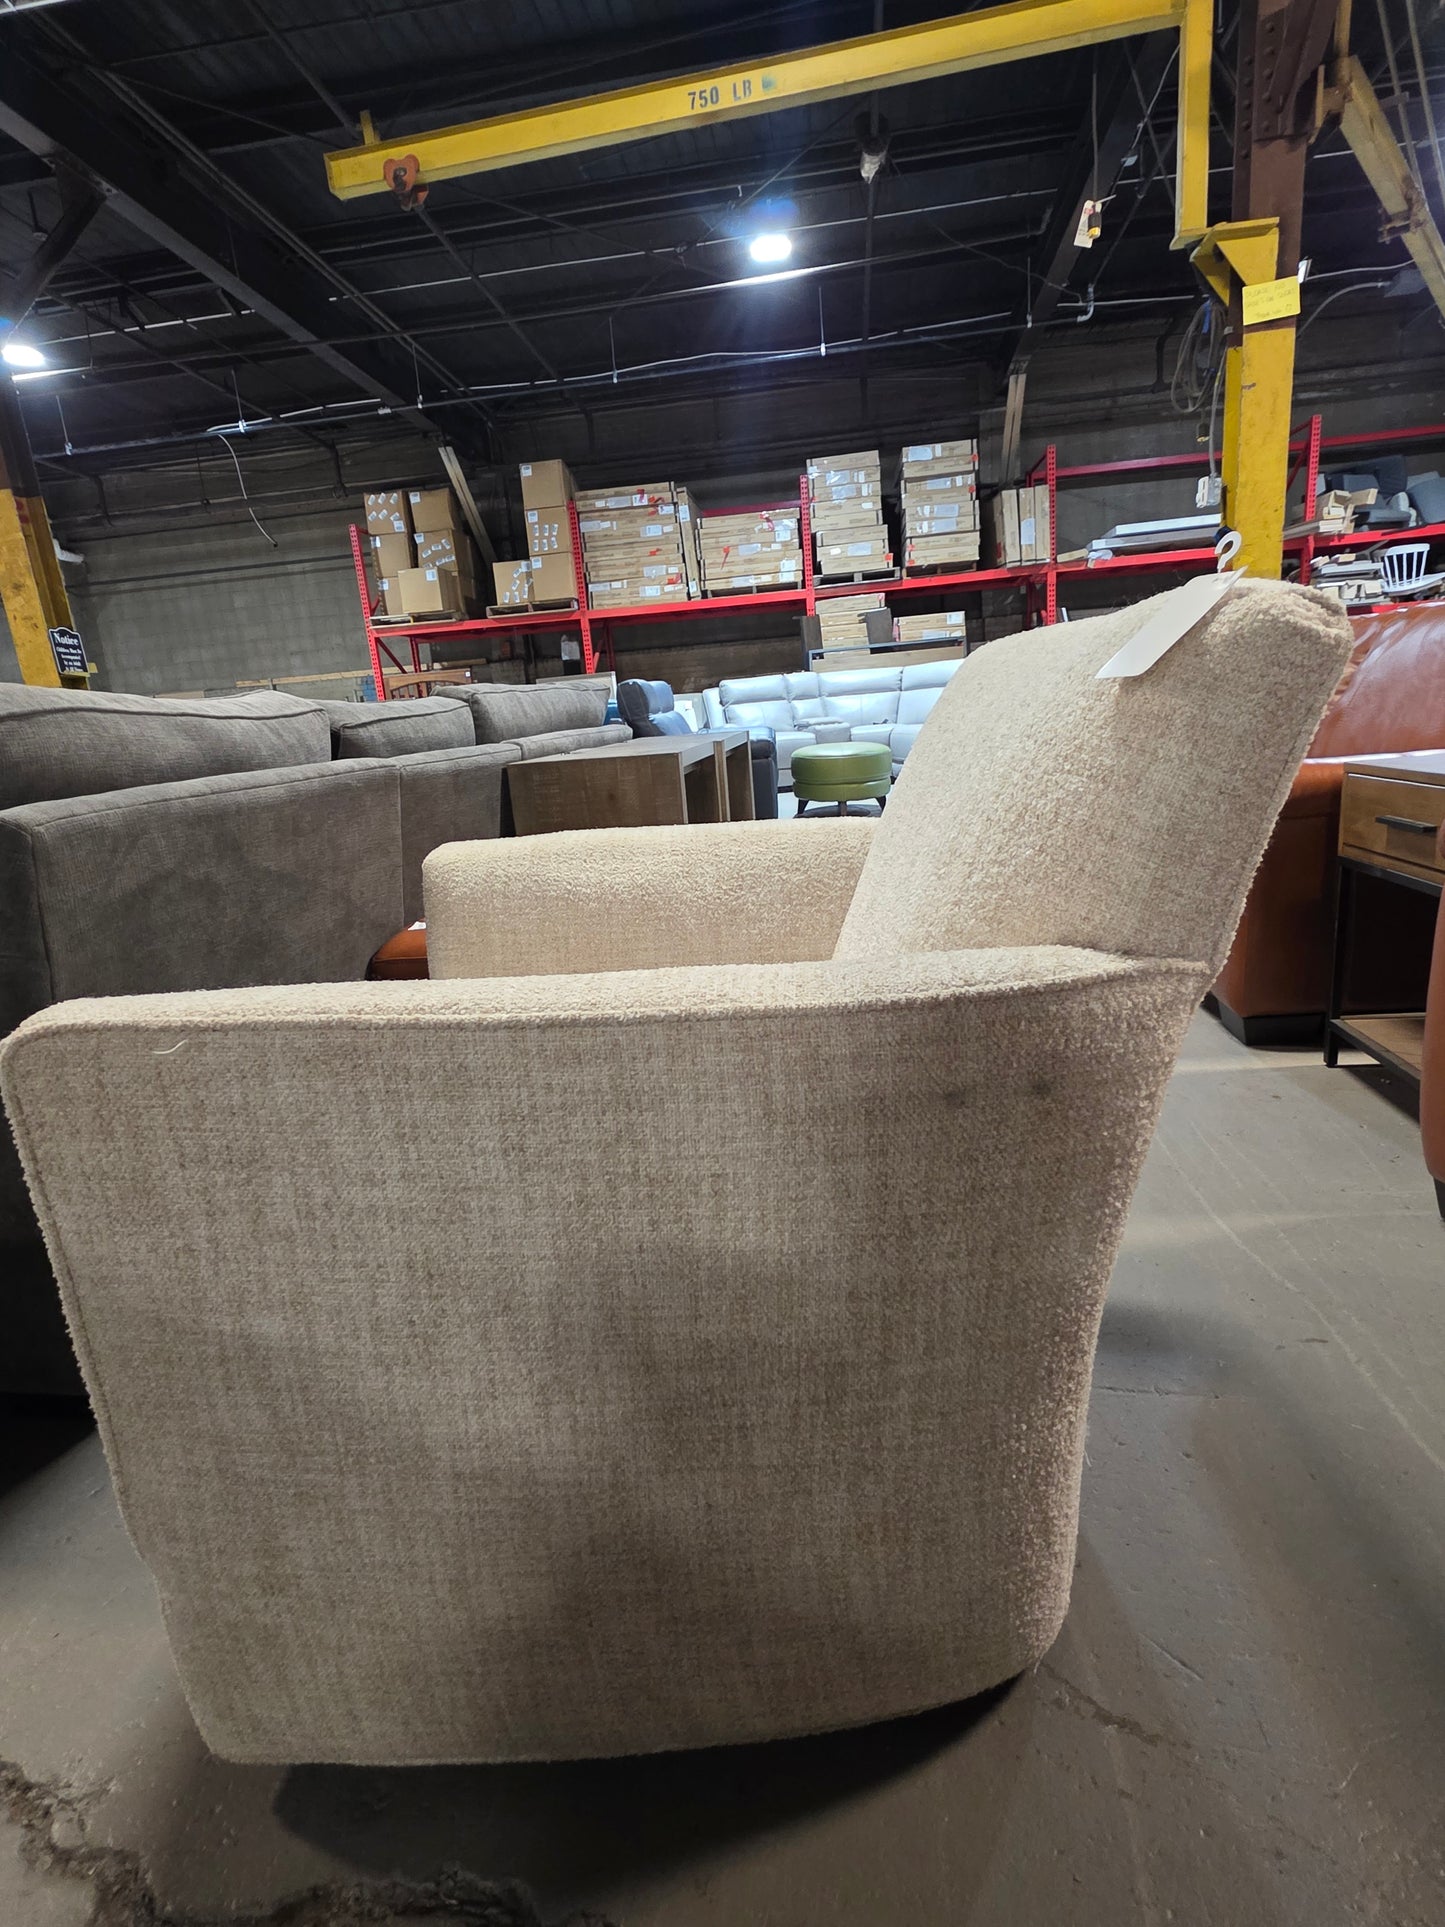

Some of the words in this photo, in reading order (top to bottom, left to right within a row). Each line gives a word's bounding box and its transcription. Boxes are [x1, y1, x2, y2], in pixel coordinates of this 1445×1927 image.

[687, 86, 719, 110] 750
[732, 79, 752, 101] LB
[54, 633, 79, 645] Notice
